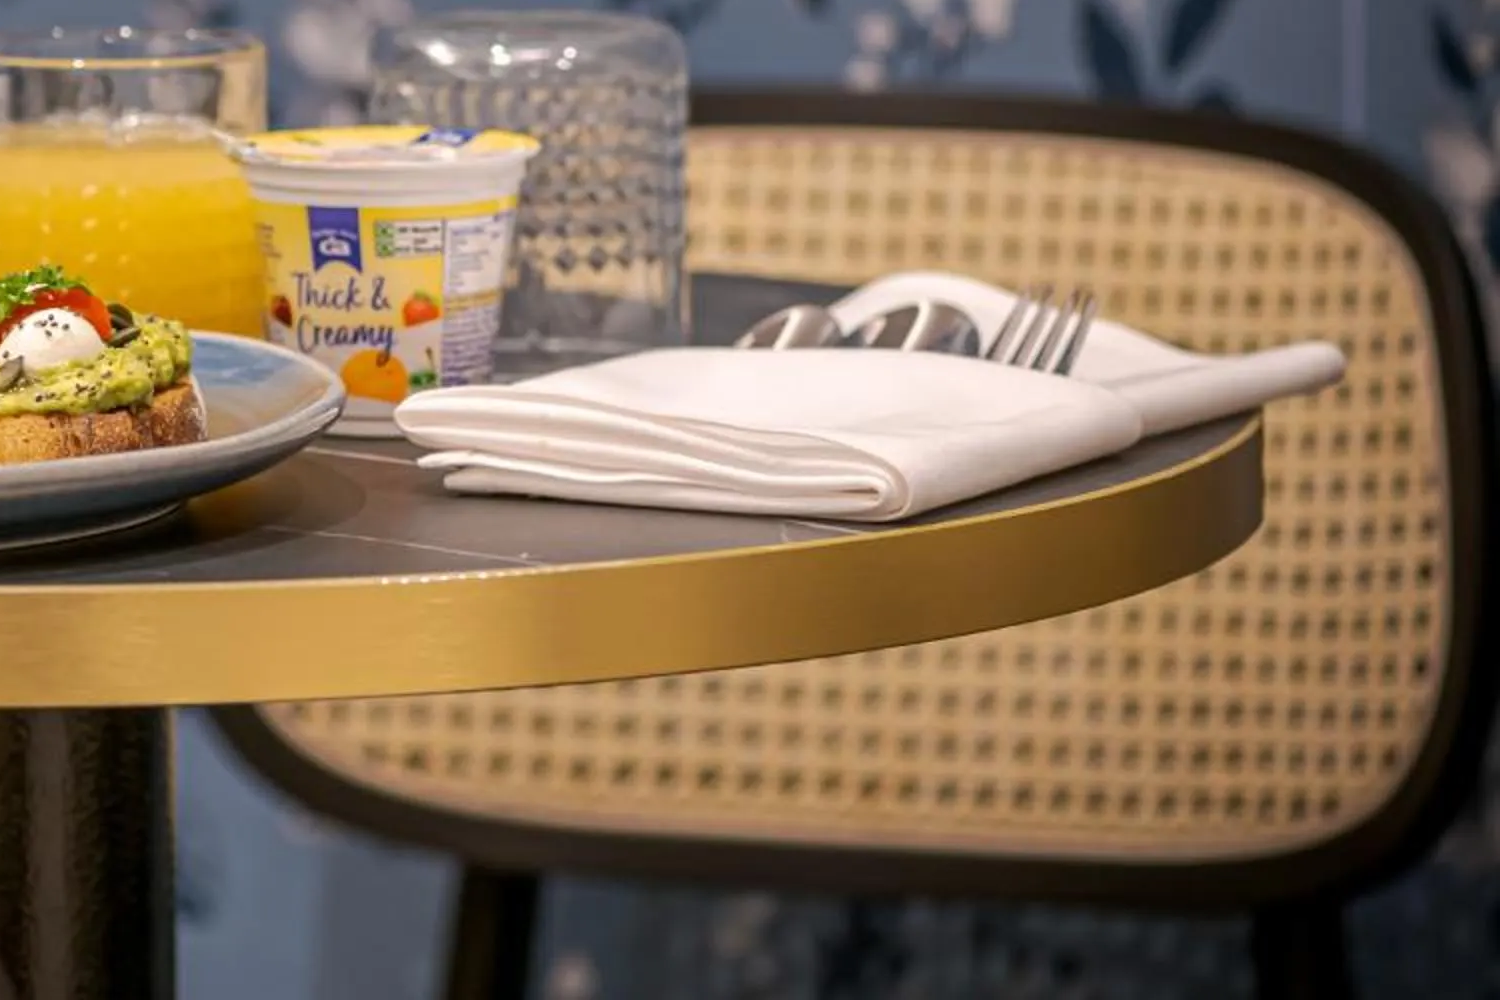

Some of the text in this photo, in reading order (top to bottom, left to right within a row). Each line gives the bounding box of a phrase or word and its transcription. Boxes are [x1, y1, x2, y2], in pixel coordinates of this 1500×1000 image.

[290, 271, 392, 312] Thick &
[297, 313, 394, 368] Creamy
